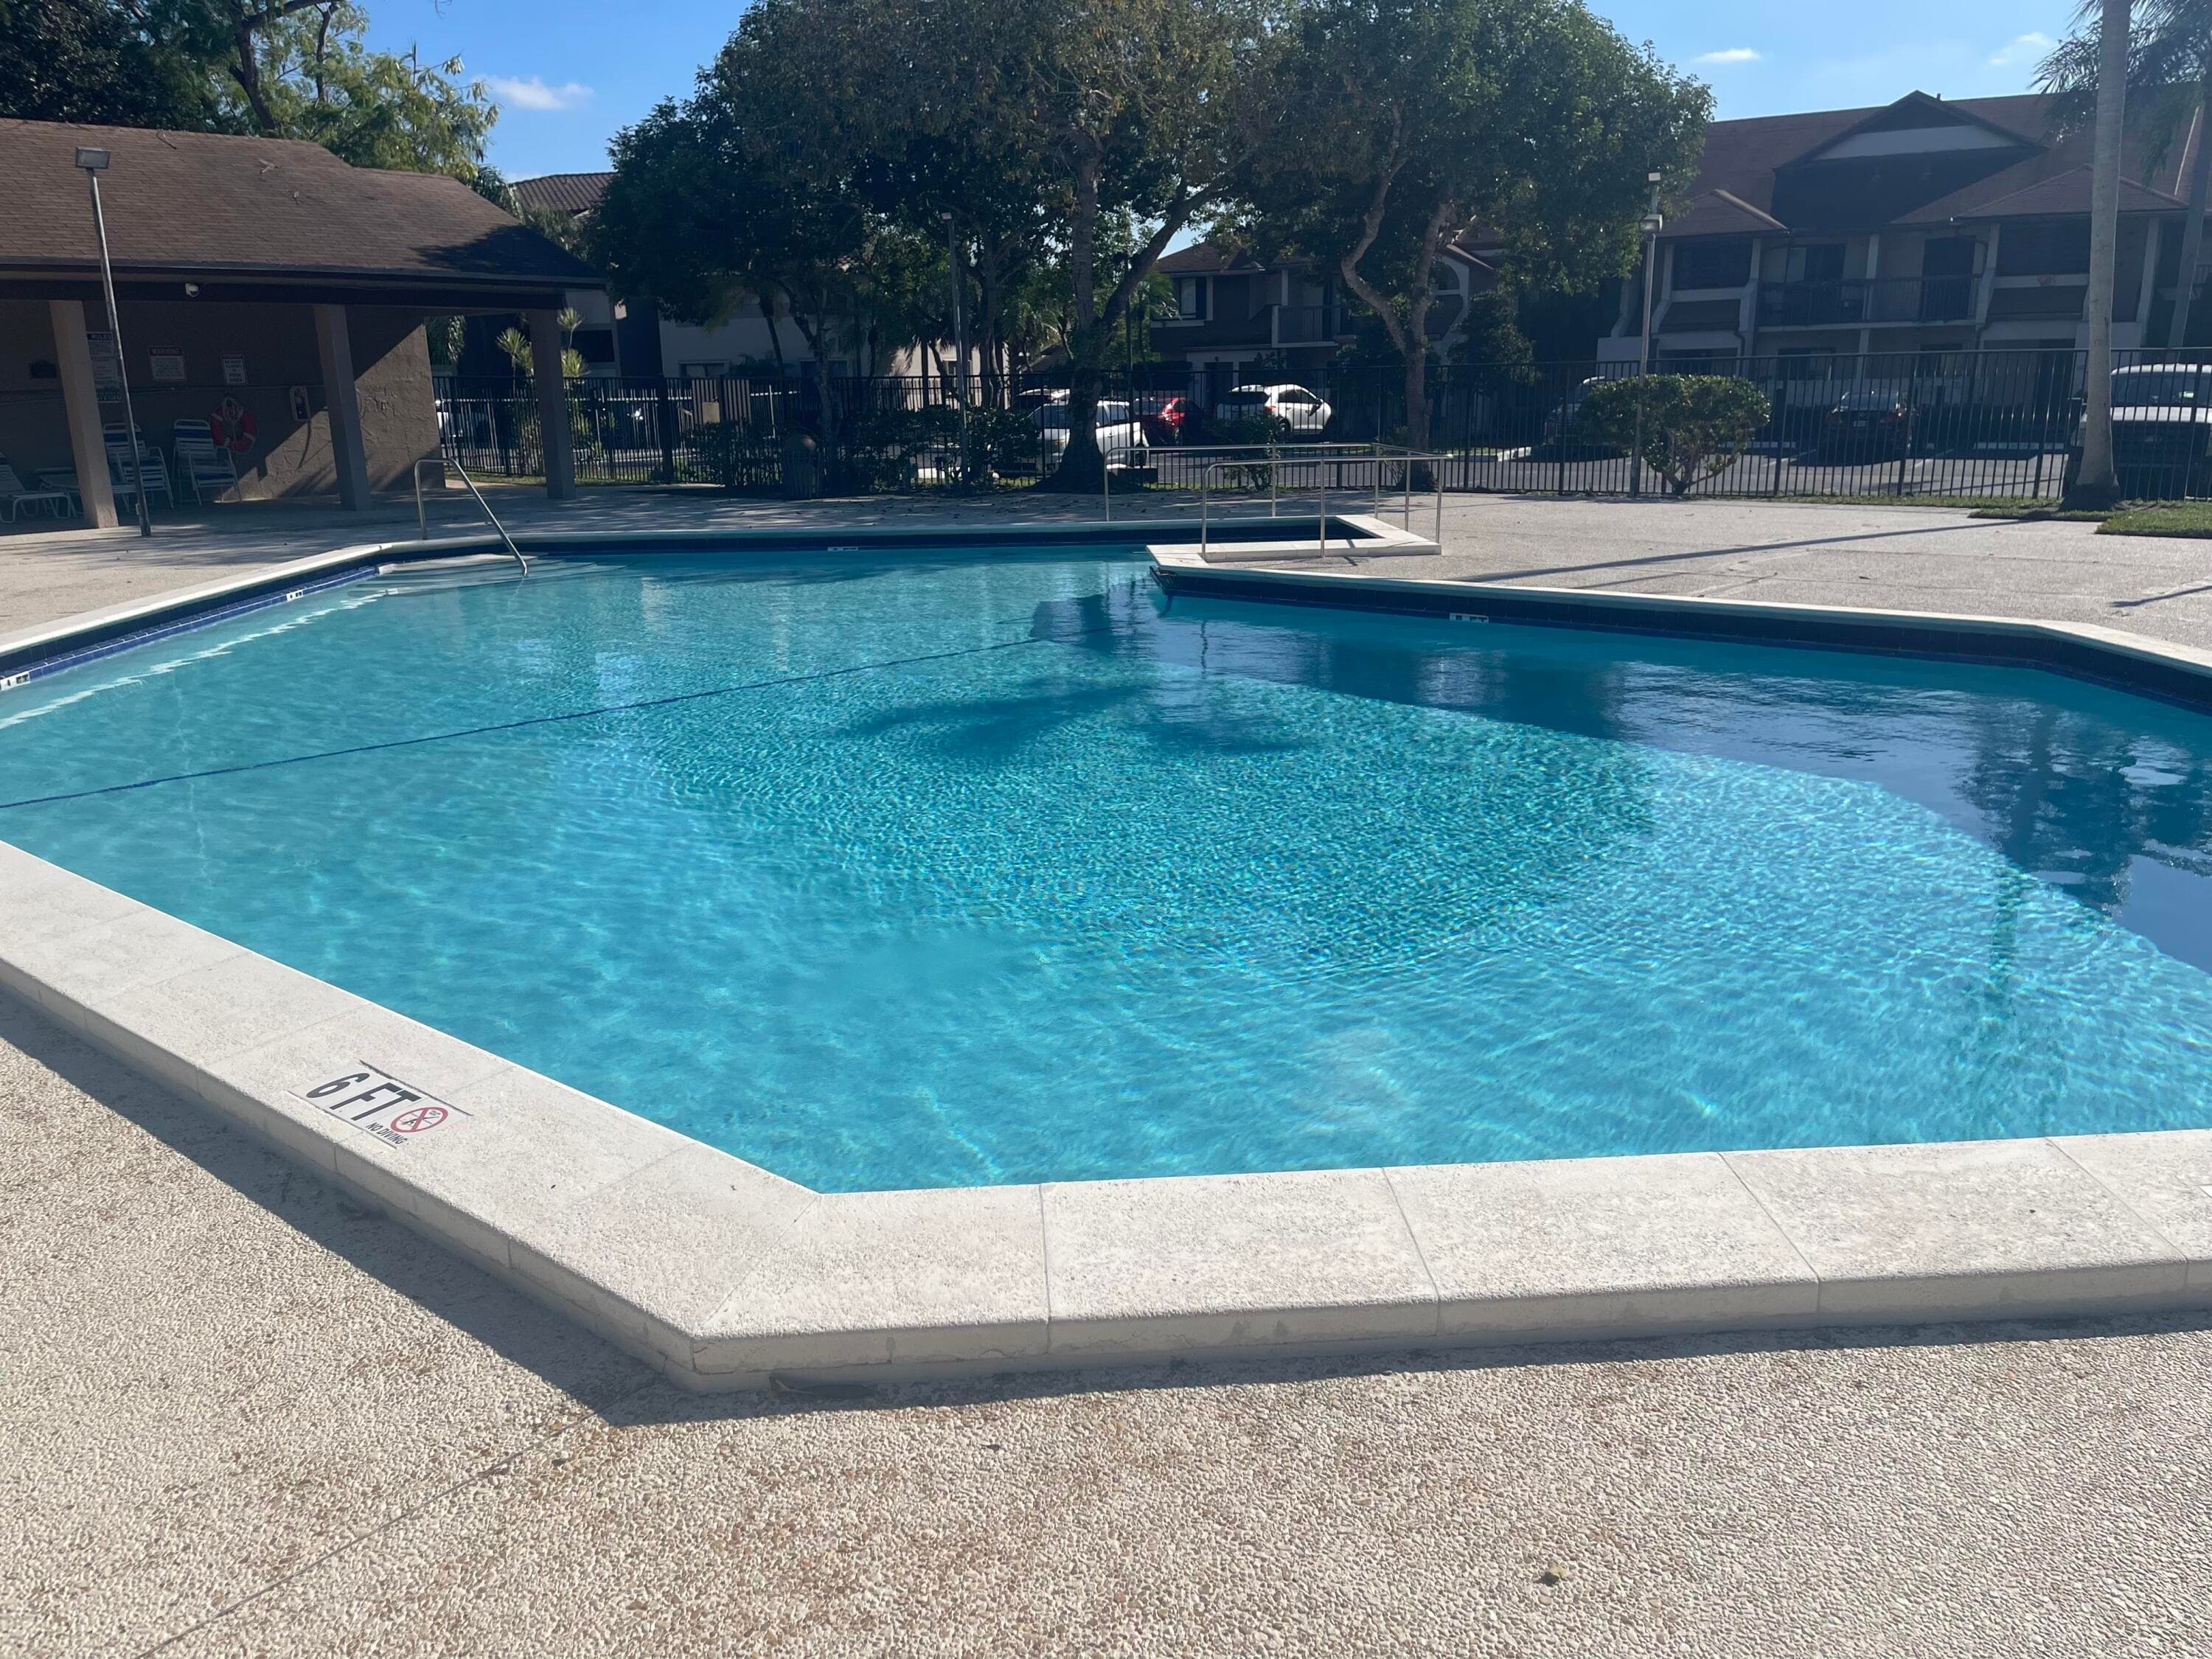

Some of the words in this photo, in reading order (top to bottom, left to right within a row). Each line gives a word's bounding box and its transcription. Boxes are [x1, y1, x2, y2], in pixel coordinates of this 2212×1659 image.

[306, 1073, 370, 1099] 6
[329, 1082, 422, 1121] FT
[366, 1121, 384, 1132] NO
[376, 1128, 408, 1144] DIVING
